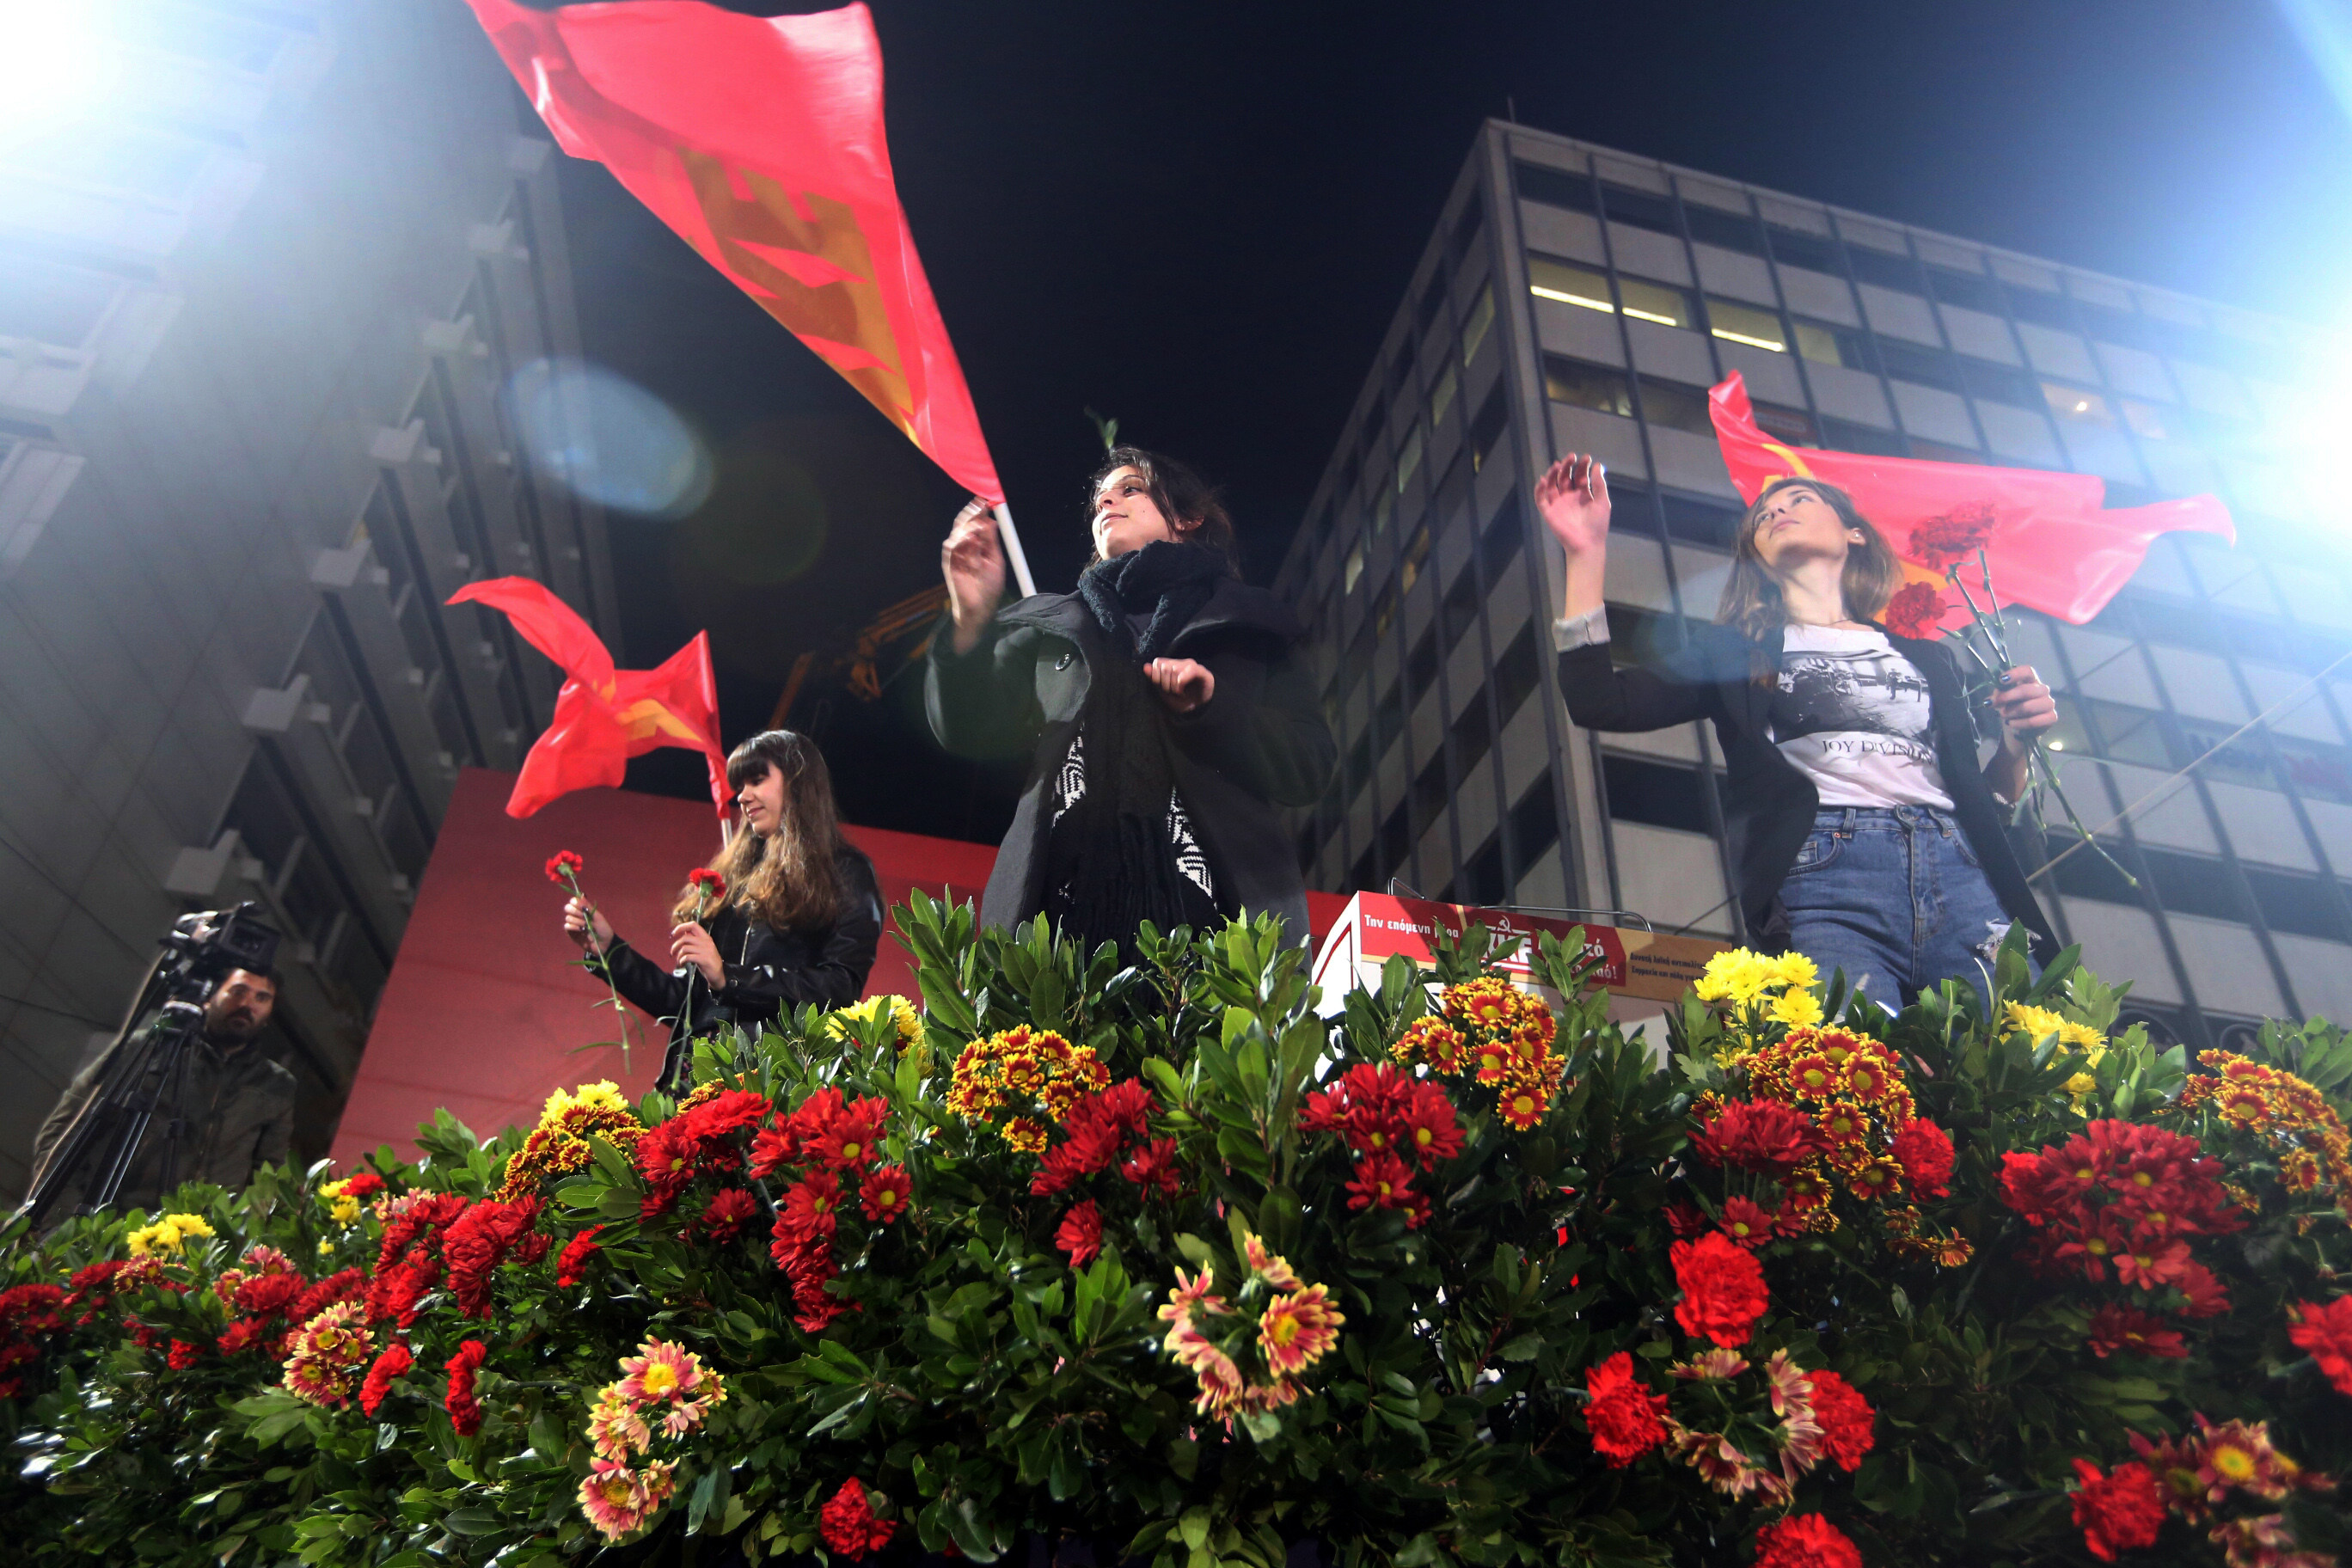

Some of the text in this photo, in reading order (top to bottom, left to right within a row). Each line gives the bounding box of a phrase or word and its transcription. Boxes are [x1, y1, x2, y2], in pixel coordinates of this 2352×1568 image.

[1822, 740, 1932, 766] JOY DIVISION
[1363, 914, 1384, 928] Την
[1387, 918, 1431, 935] επόμενη
